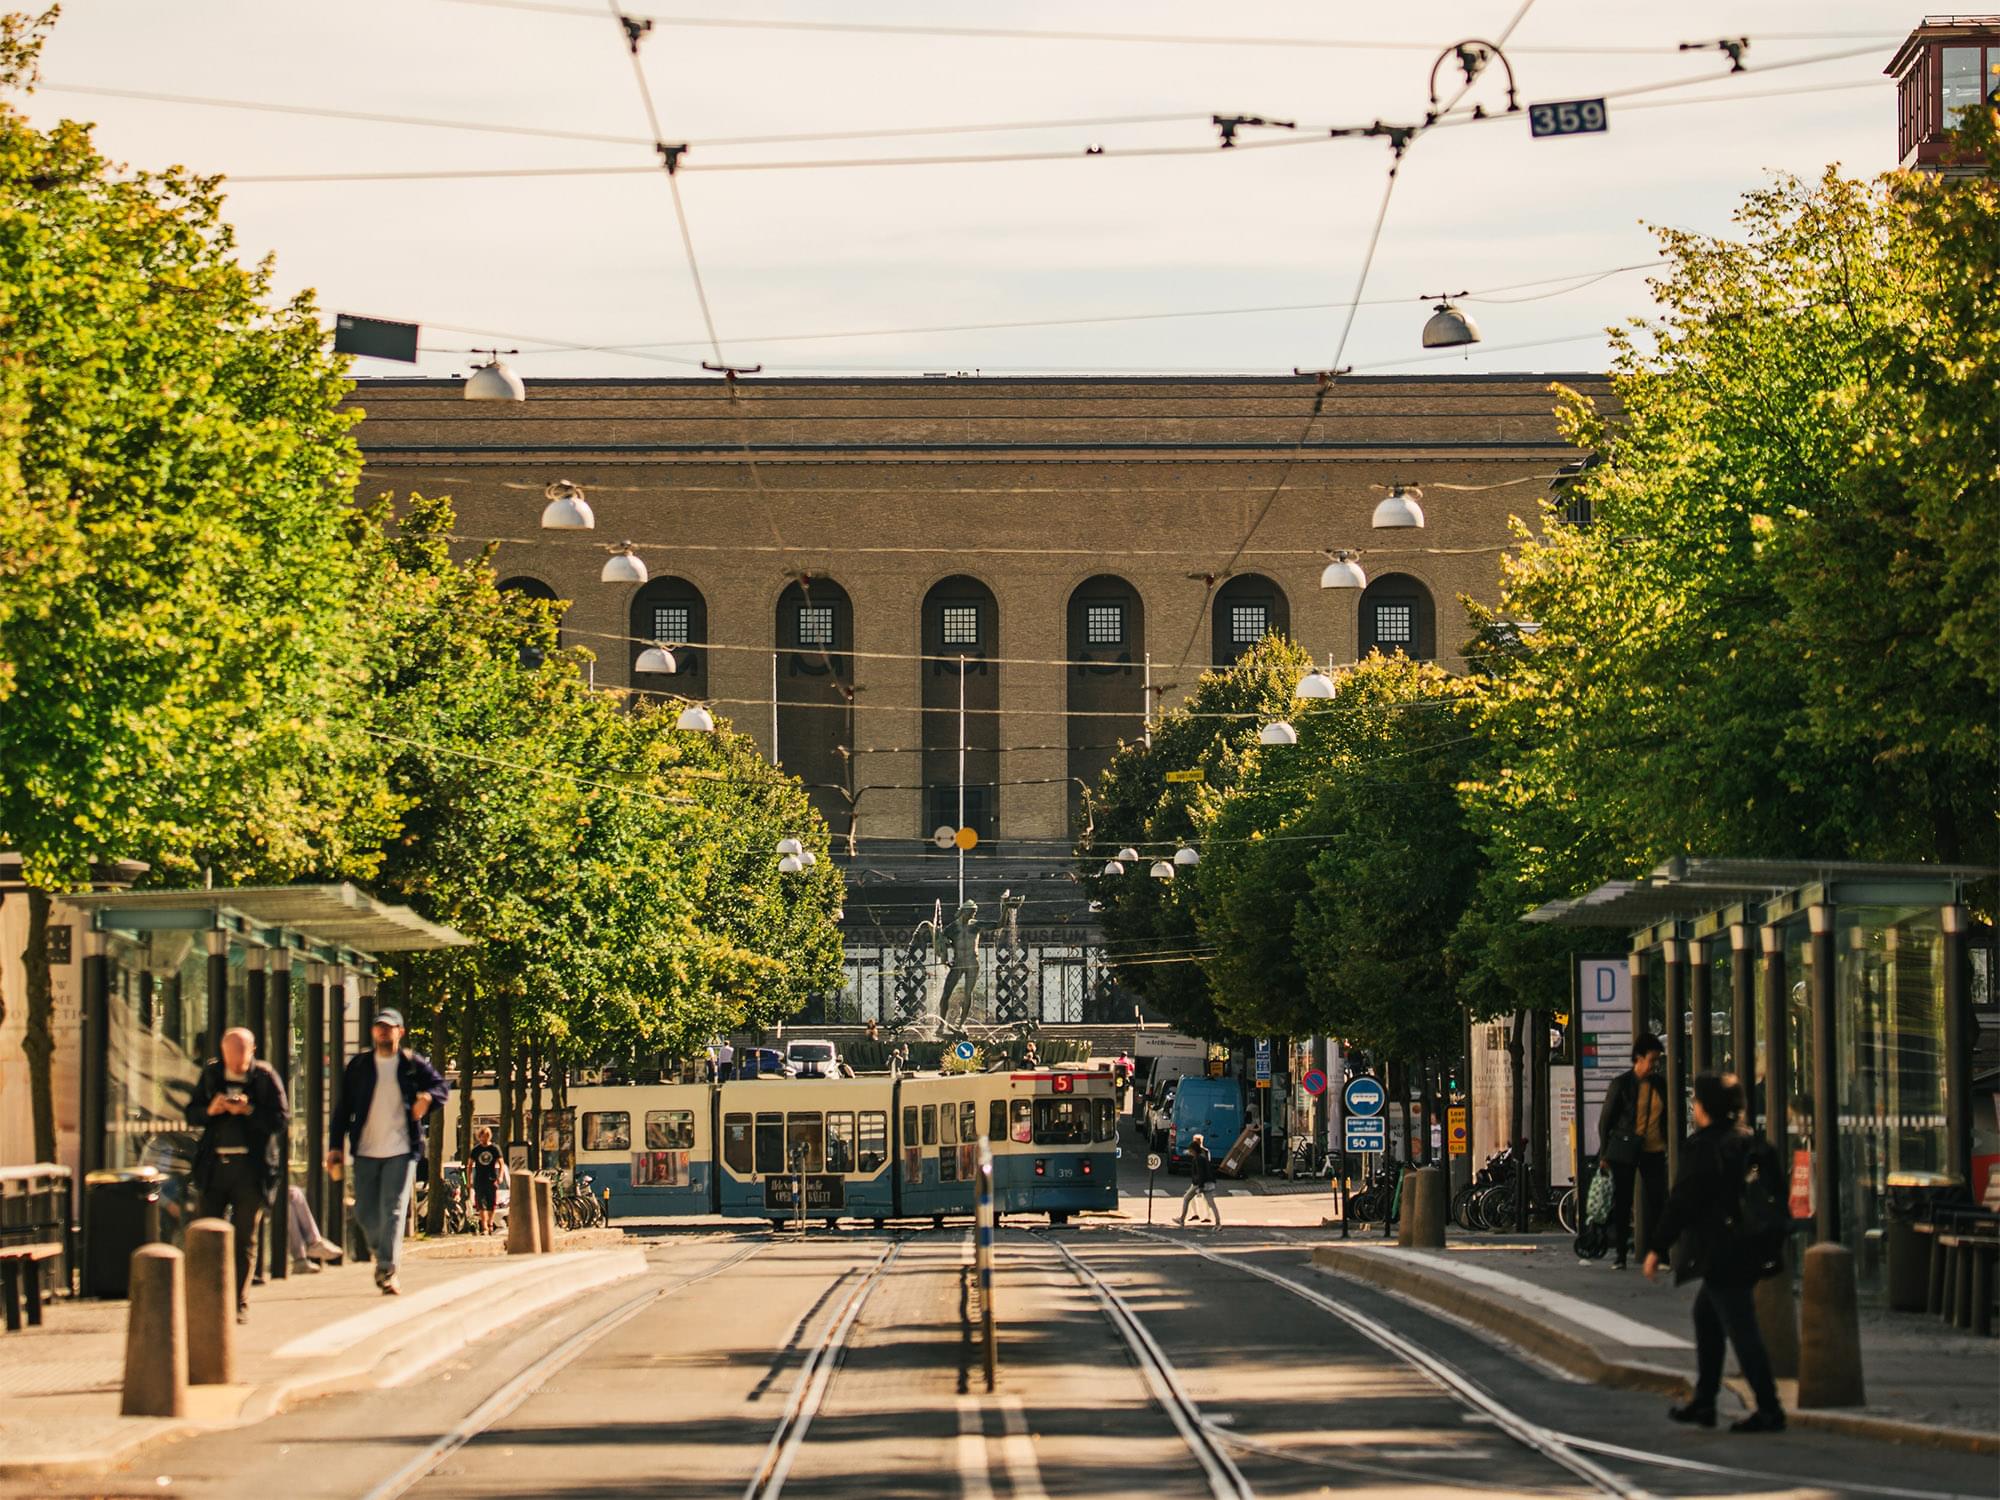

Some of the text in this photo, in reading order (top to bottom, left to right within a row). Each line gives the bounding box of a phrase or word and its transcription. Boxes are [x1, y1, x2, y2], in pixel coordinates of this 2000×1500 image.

[1533, 102, 1604, 135] 359
[1596, 967, 1616, 1003] D
[1258, 1039, 1268, 1052] P
[1056, 1077, 1068, 1091] 5
[1352, 1138, 1379, 1148] 50 m
[1147, 1157, 1159, 1167] 30
[1058, 1168, 1073, 1178] 319
